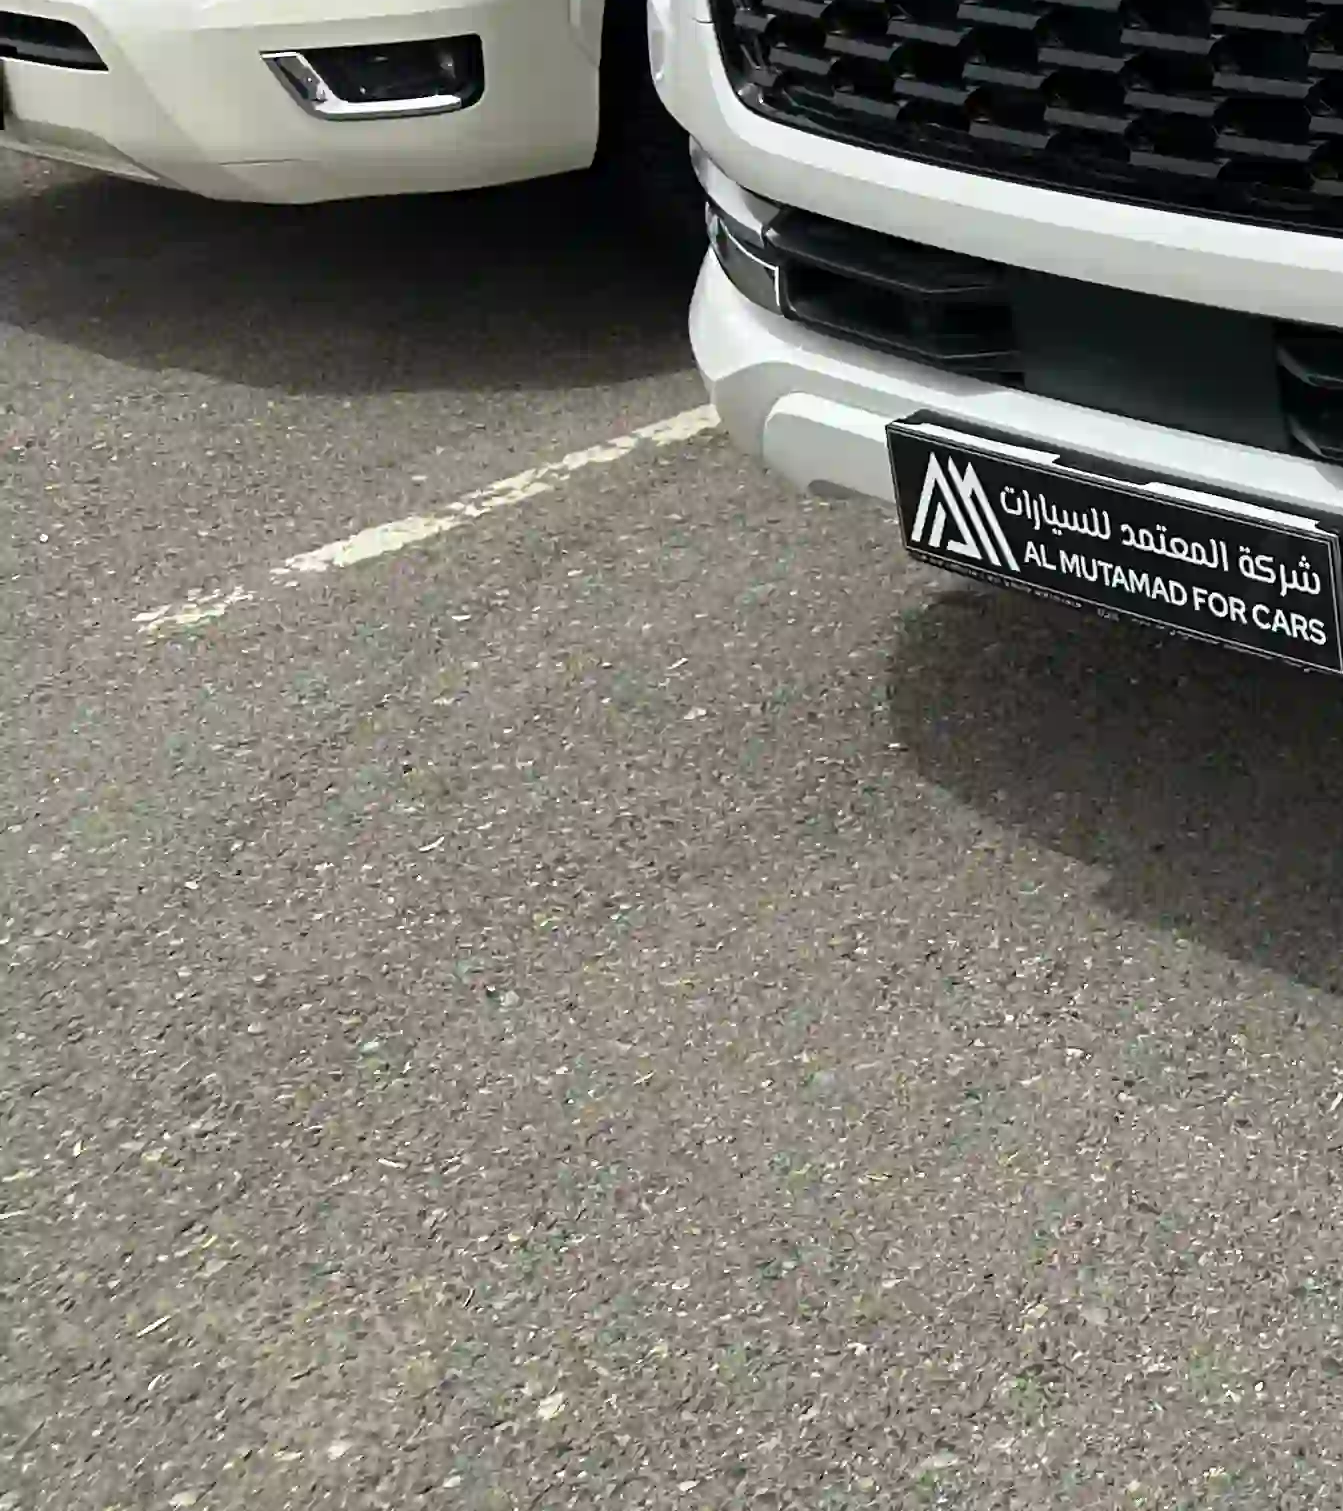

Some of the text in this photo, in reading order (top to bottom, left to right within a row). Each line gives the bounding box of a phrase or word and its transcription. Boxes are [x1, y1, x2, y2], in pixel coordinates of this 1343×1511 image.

[999, 485, 1321, 597] شركة المعتمد للسيارات
[1023, 541, 1058, 571] AL
[1060, 550, 1189, 607] MUTAMAD
[1192, 588, 1248, 626] FOR
[1252, 602, 1327, 647] CARS
